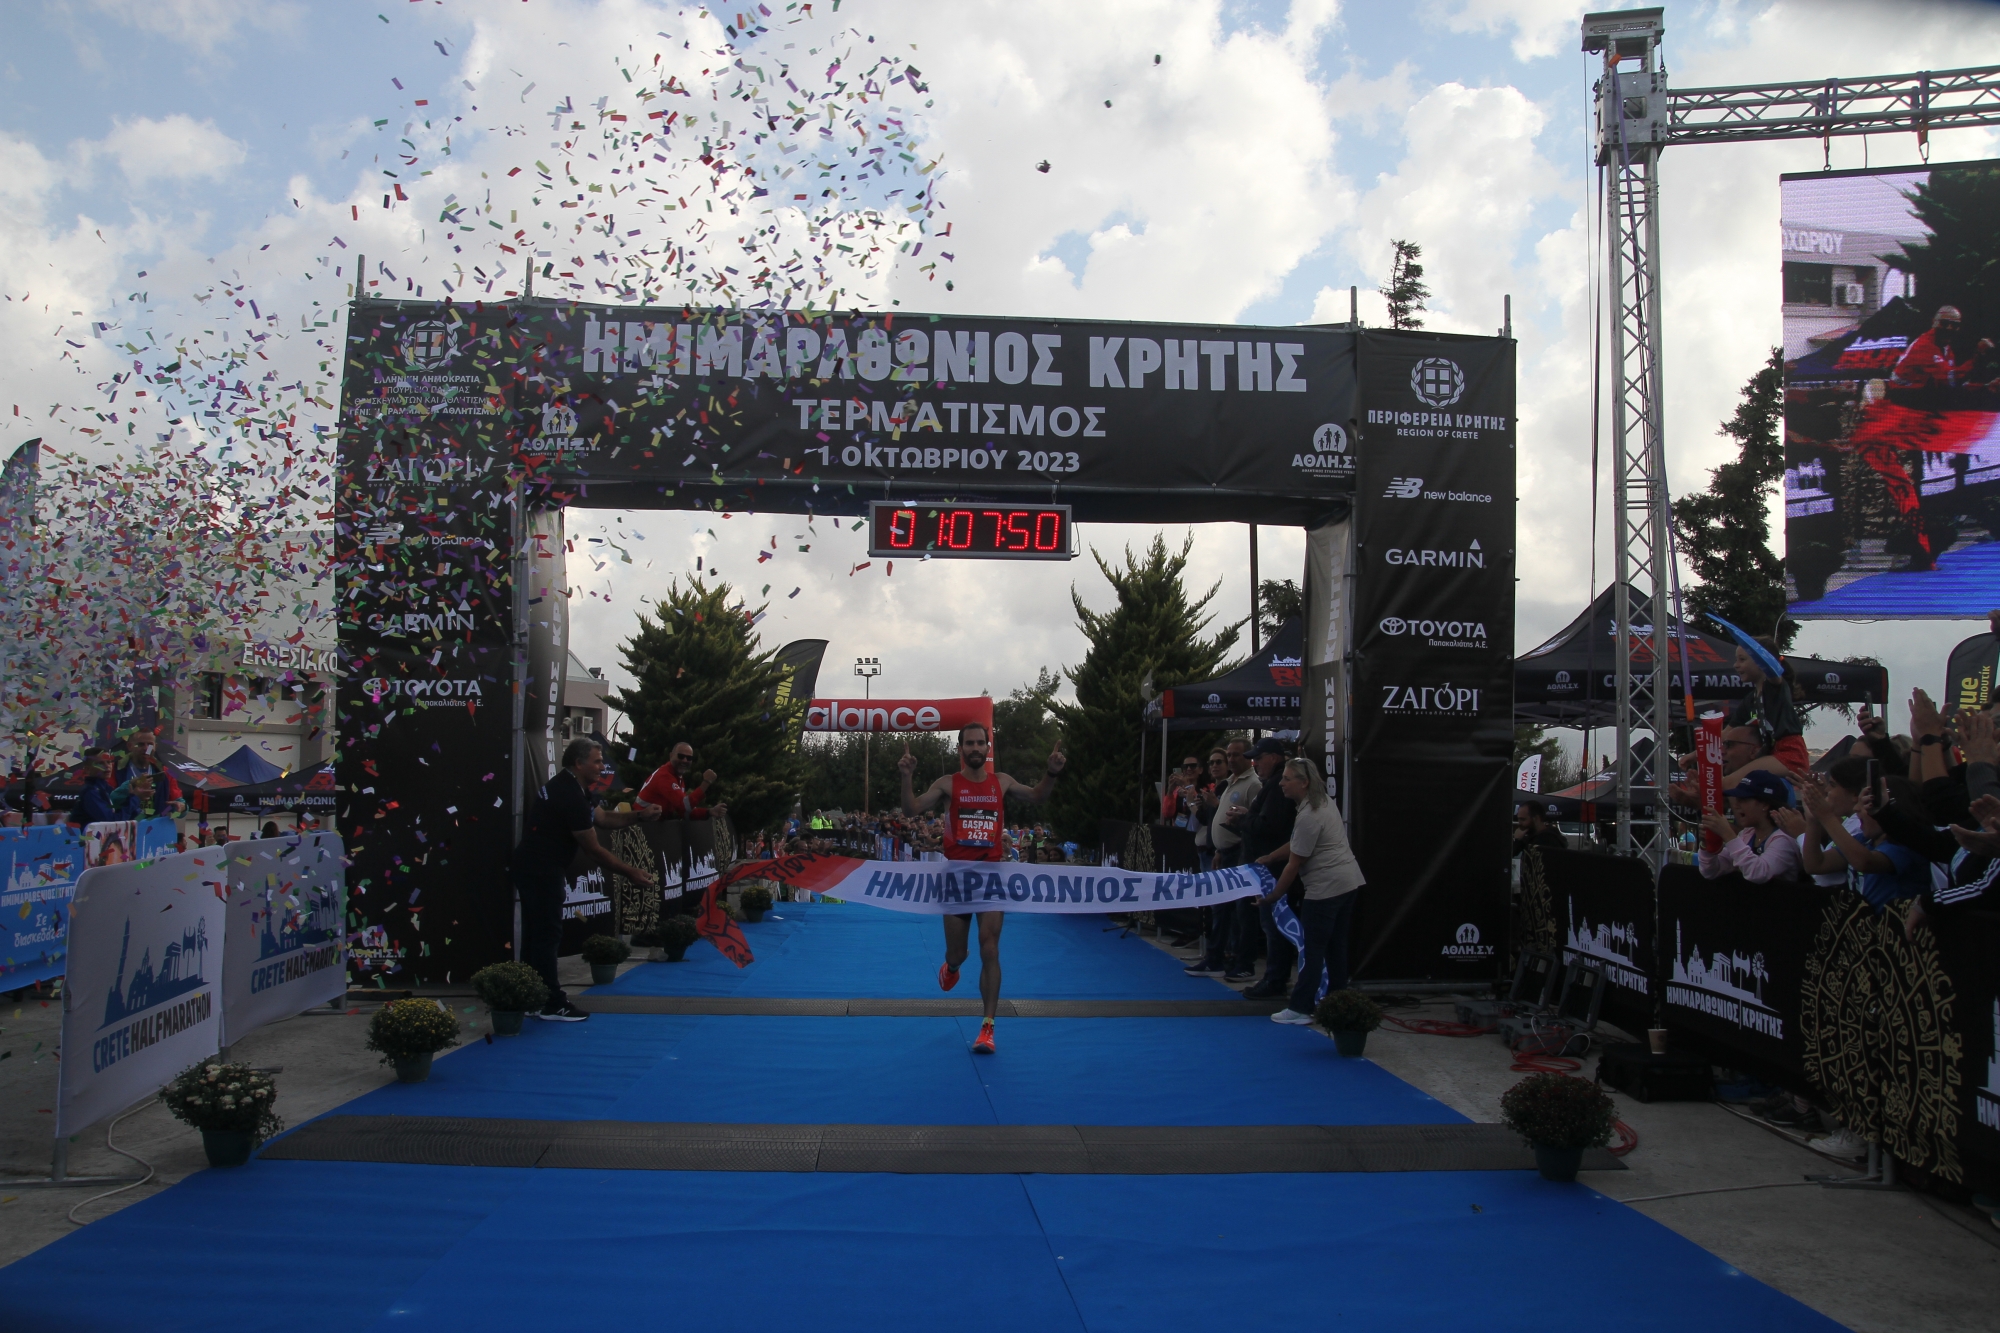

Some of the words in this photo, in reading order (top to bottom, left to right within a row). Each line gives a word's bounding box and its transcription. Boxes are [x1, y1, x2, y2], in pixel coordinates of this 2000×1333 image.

[582, 320, 1063, 386] ΗΜΙΜΑΡΑΘΩΝΙΟΣ
[1089, 336, 1307, 392] ΚΡΗΤΗΣ
[425, 396, 439, 404] ΚΑΙ
[792, 399, 1106, 437] ΤΕΡΜΑΤΙΣΜΟΣ
[1368, 410, 1452, 427] ΠΕΡΙΦΕΡΕΙΑ
[1456, 413, 1505, 431] ΚΡΗΤΗΣ
[1397, 428, 1433, 438] REGION
[1437, 430, 1450, 438] OF
[1452, 430, 1479, 440] CRETE
[818, 446, 829, 466] 1
[1017, 450, 1080, 472] 2023
[1424, 490, 1446, 500] new
[1448, 490, 1492, 503] balance
[1385, 548, 1484, 569] GARMIN
[367, 613, 475, 631] GARMIN
[1407, 620, 1486, 639] TOYOTA
[392, 679, 482, 696] TOYOTA
[1603, 674, 1653, 687] CTE
[1246, 696, 1287, 707] CRETE
[1324, 676, 1338, 803] ΘΩΝΙΟΣ
[1520, 772, 1528, 790] OTA
[1706, 767, 1714, 787] new
[962, 820, 994, 830] GASPAR
[968, 831, 988, 840] 2422
[864, 870, 1142, 904] ΗΜΙΜΑΡΑΘΩΝΙΟΣ
[1152, 867, 1252, 902] ΚΡΗΤΗΣ
[35, 913, 48, 928] Σε
[1619, 968, 1648, 995] ΚΡΗΤΗΣ
[1666, 986, 1739, 1024] ΗΜΙΜΑΡΑΘΩΝΙΟΣ
[1742, 1006, 1783, 1040] ΚΡΗΤΗΣ
